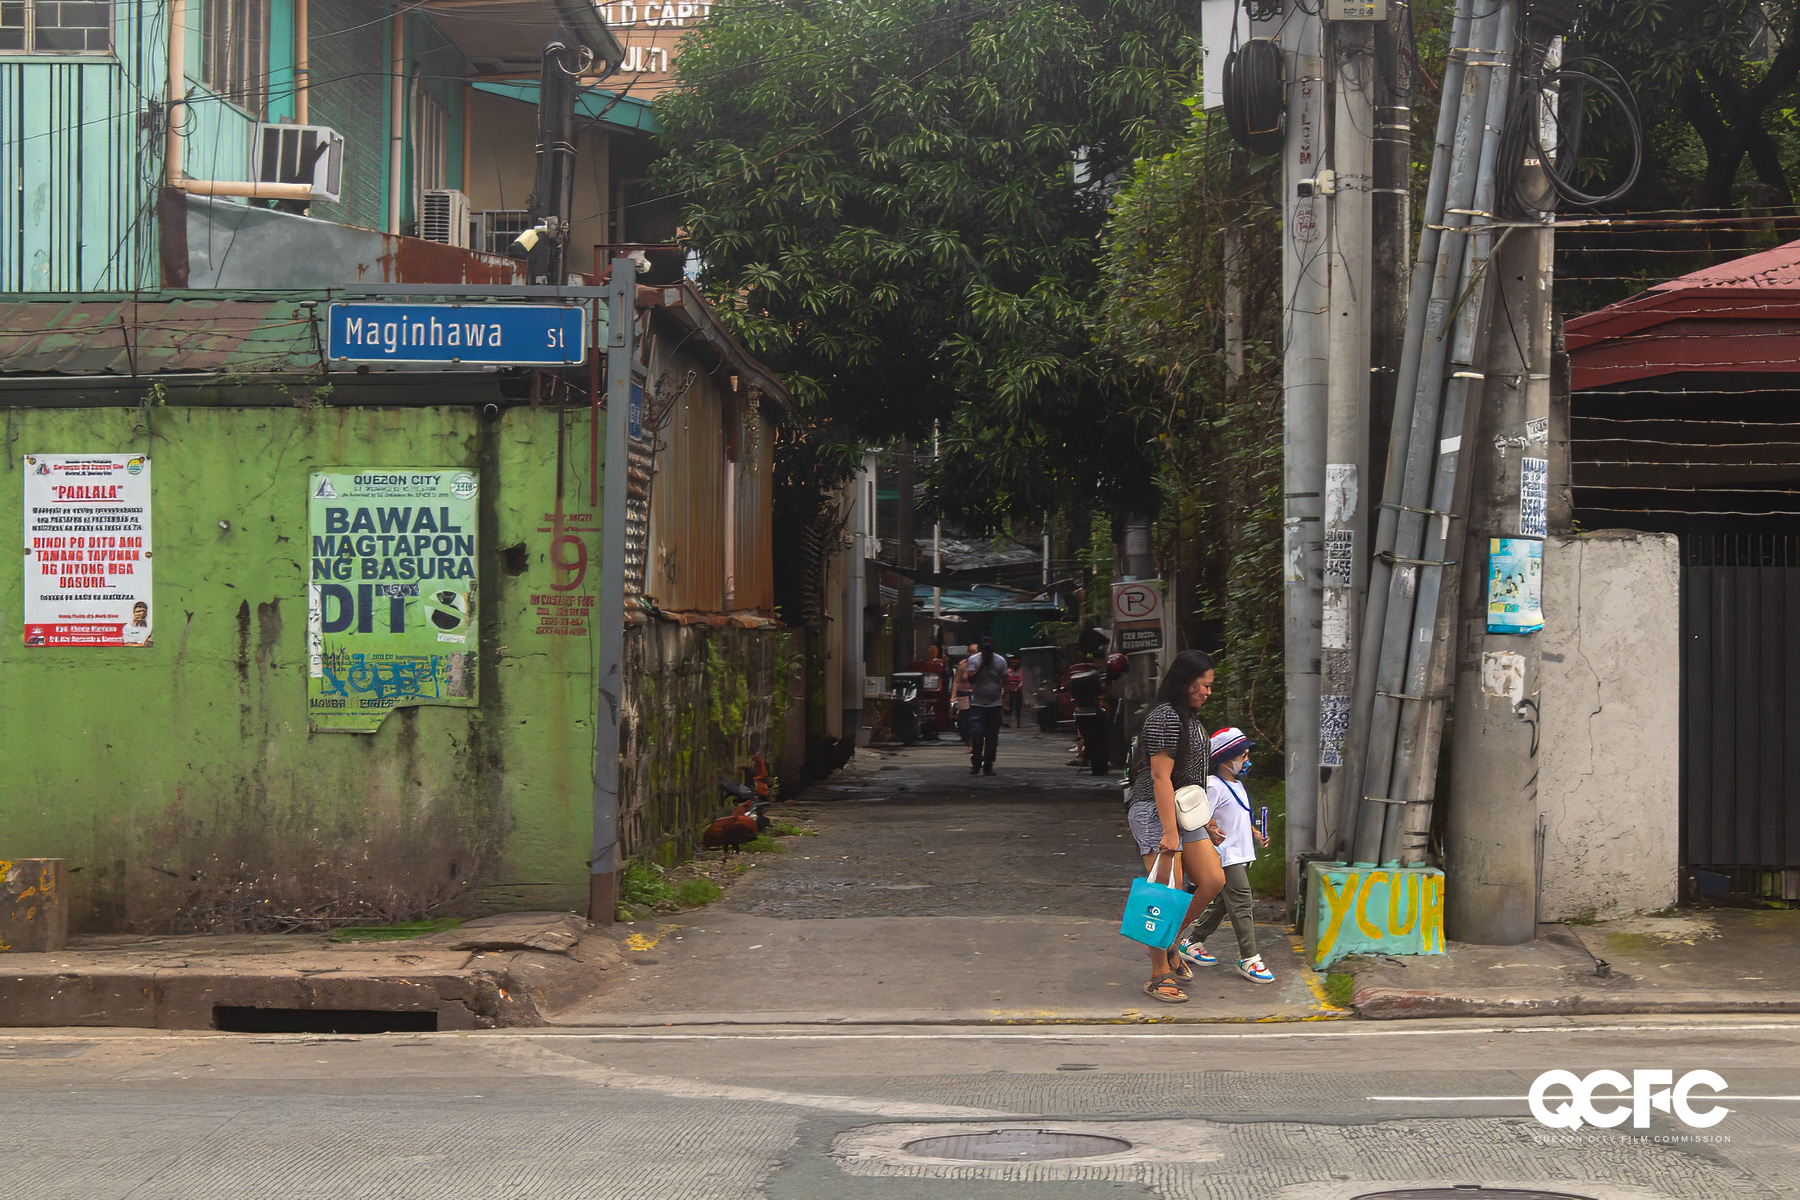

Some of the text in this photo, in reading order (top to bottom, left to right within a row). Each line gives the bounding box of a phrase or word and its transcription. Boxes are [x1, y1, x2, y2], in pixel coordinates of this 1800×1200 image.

[345, 314, 502, 353] Maginhawa
[354, 475, 441, 485] QUEZON CITY
[325, 507, 462, 534] BAWAL
[312, 535, 474, 557] MAGTAPON
[312, 557, 476, 580] NG BASURA
[550, 535, 588, 592] 9
